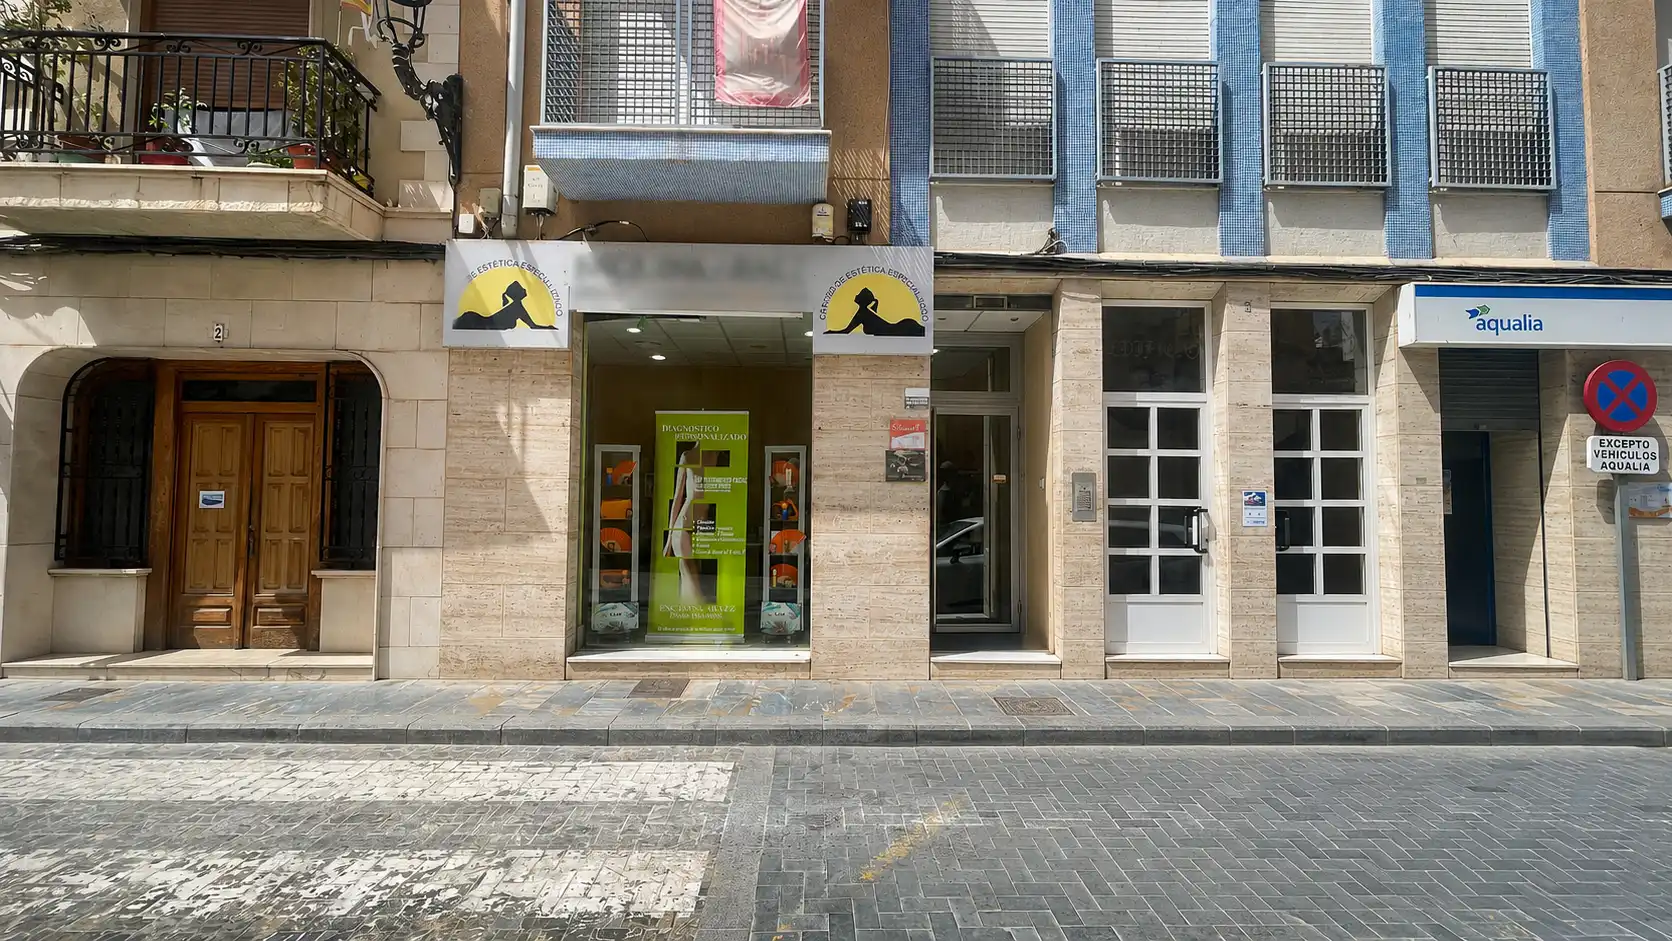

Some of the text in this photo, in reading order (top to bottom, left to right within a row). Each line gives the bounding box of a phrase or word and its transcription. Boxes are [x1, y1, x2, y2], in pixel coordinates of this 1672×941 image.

[477, 259, 520, 274] ESTÉTICA
[845, 265, 886, 280] ESTÉTICA
[1475, 313, 1544, 336] aqualia
[214, 327, 221, 339] 2
[1599, 438, 1651, 450] EXCEPTO
[1593, 449, 1658, 461] VEHICULOS
[1600, 460, 1652, 472] AQUALIA
